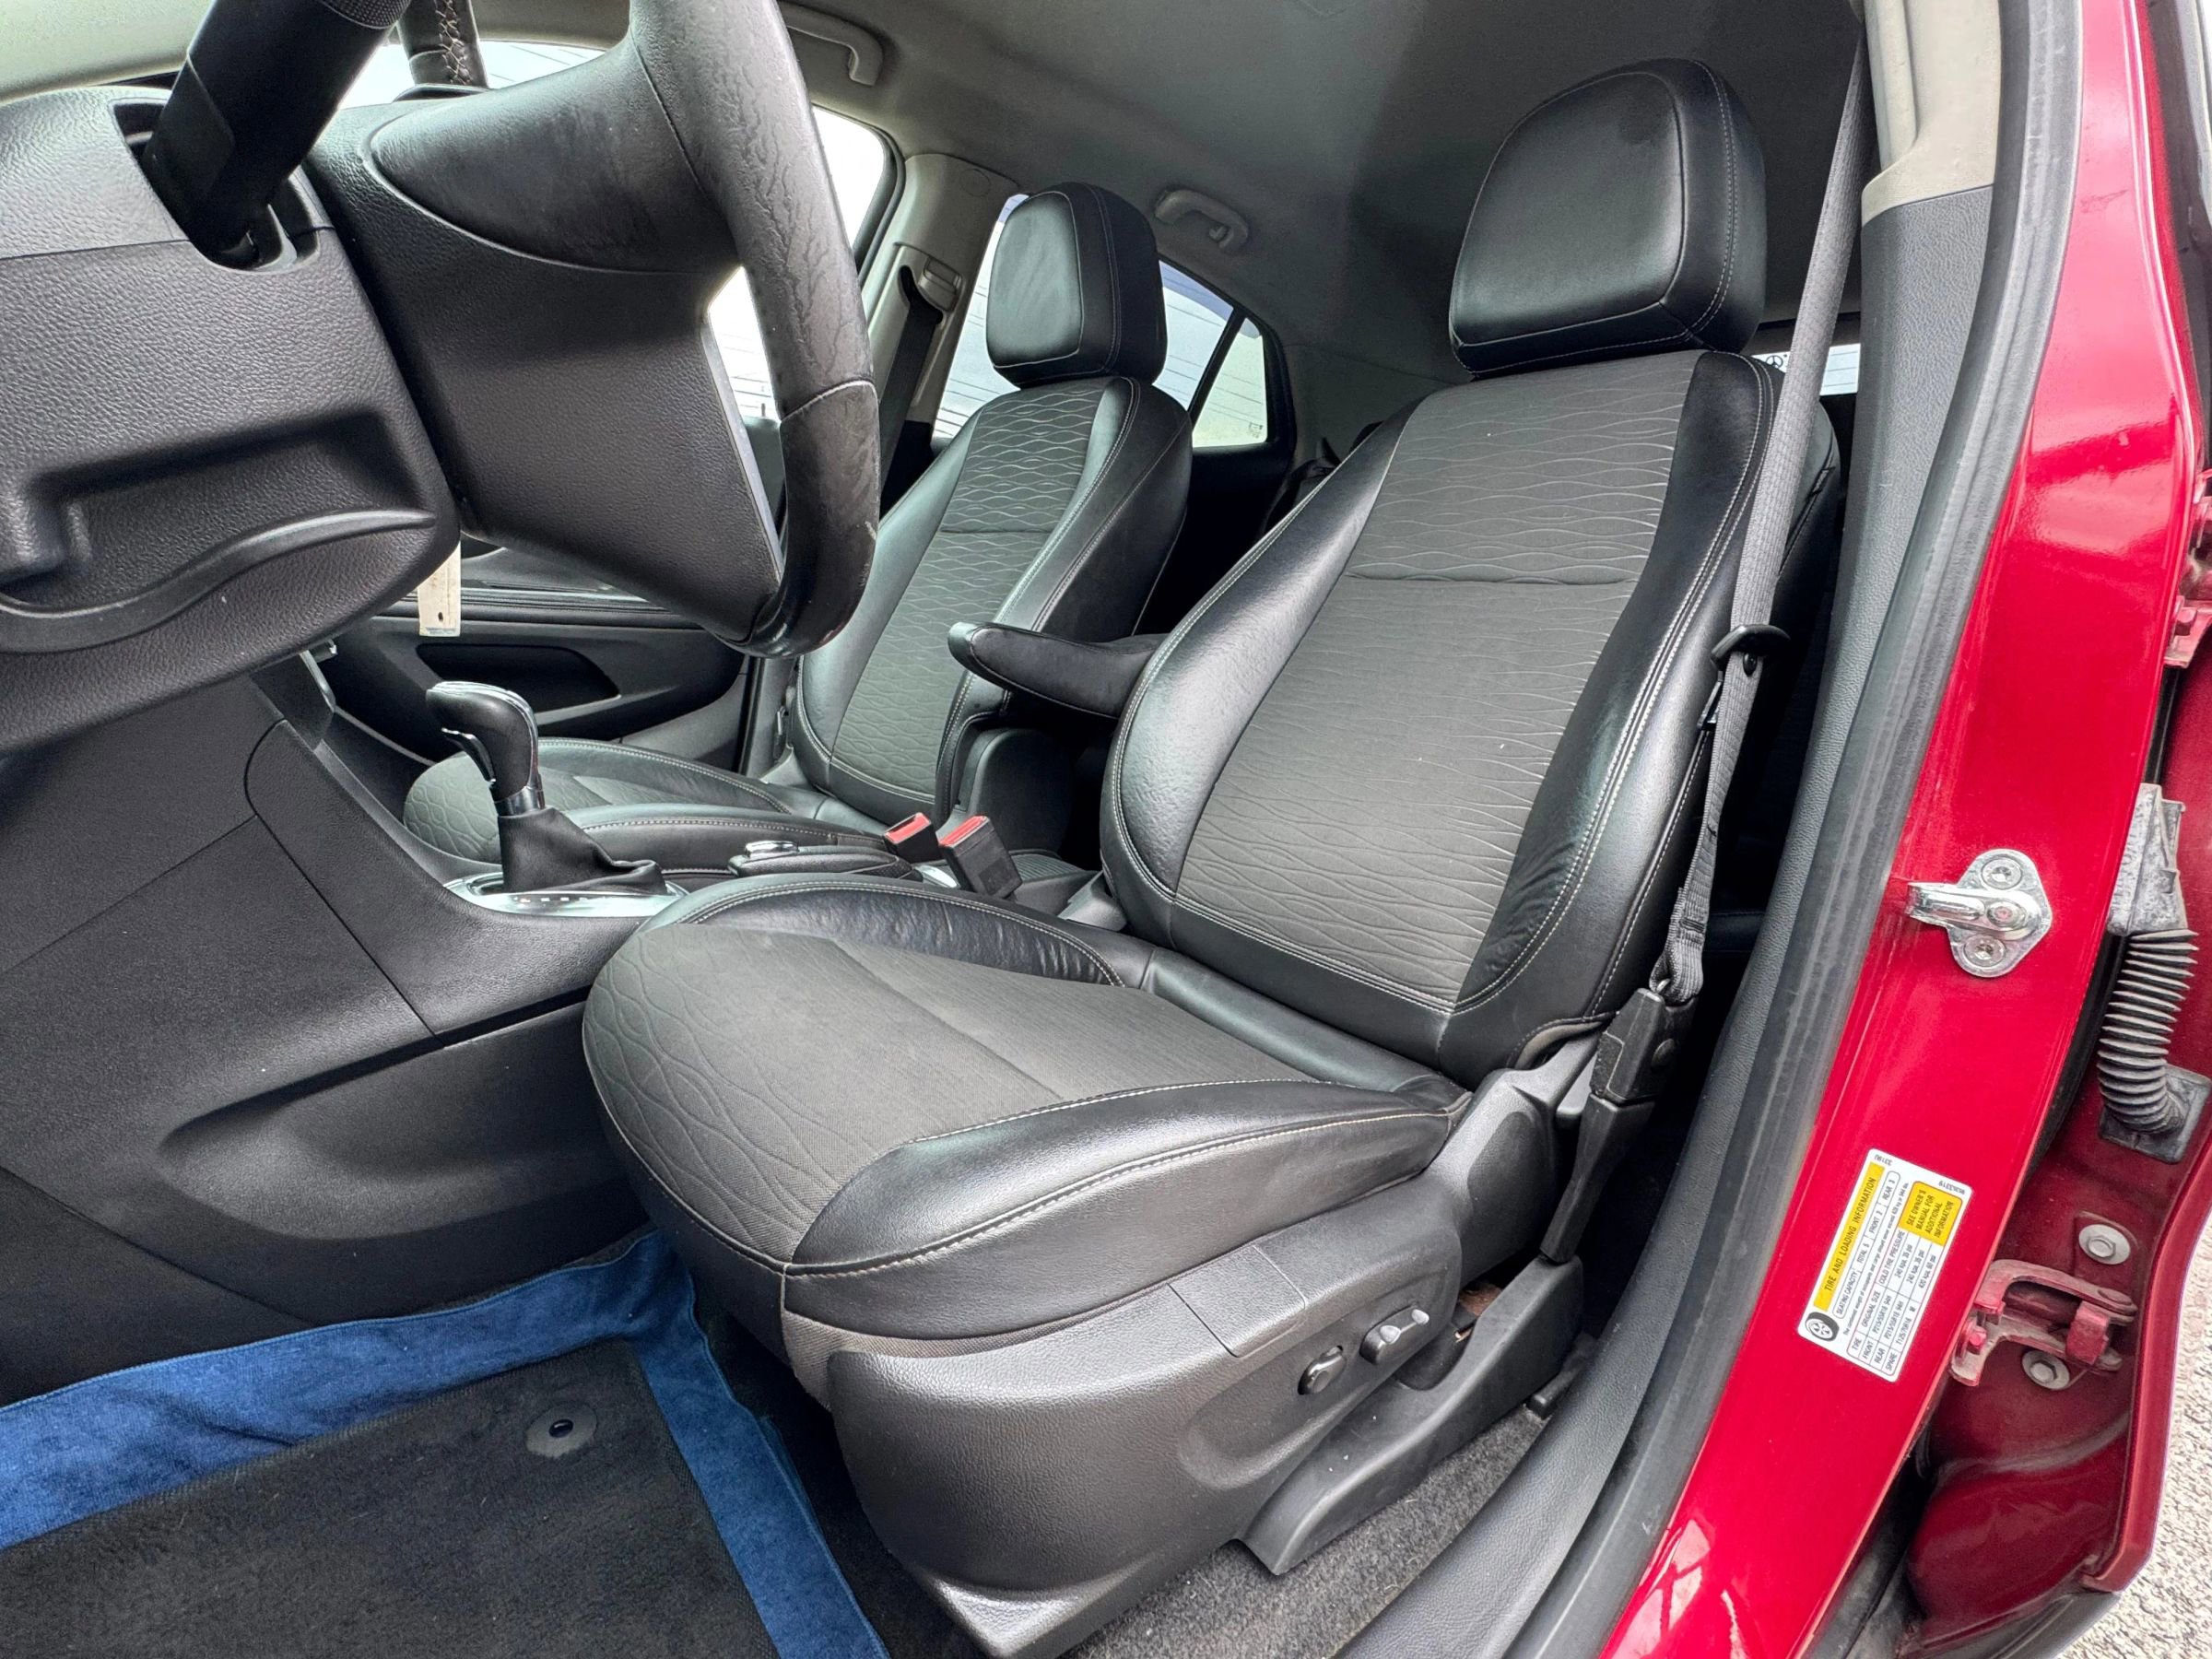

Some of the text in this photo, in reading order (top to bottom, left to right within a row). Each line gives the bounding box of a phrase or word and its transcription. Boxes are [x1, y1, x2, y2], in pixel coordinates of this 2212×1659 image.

[1906, 1214, 1915, 1226] SEE
[1914, 1194, 1935, 1230] MANUAL FOR
[1924, 1200, 1942, 1234] ADDITIONAL
[1934, 1200, 1954, 1238] INFORMATION
[1824, 1176, 1876, 1291] TIRE AND LOADING INFORMATION
[1836, 1293, 1848, 1314] SEATING
[1843, 1271, 1857, 1295] CAPACITY
[1856, 1248, 1866, 1264] TOTAL
[1868, 1216, 1879, 1233] FRONT
[1881, 1185, 1892, 1200] REAR
[1851, 1230, 1905, 1350] TIRE ORIGINAL SIZE COLD TIRE PRESSURE
[1862, 1339, 1874, 1359] FRONT
[1874, 1347, 1885, 1364] REAR
[1885, 1351, 1897, 1371] SPARE
